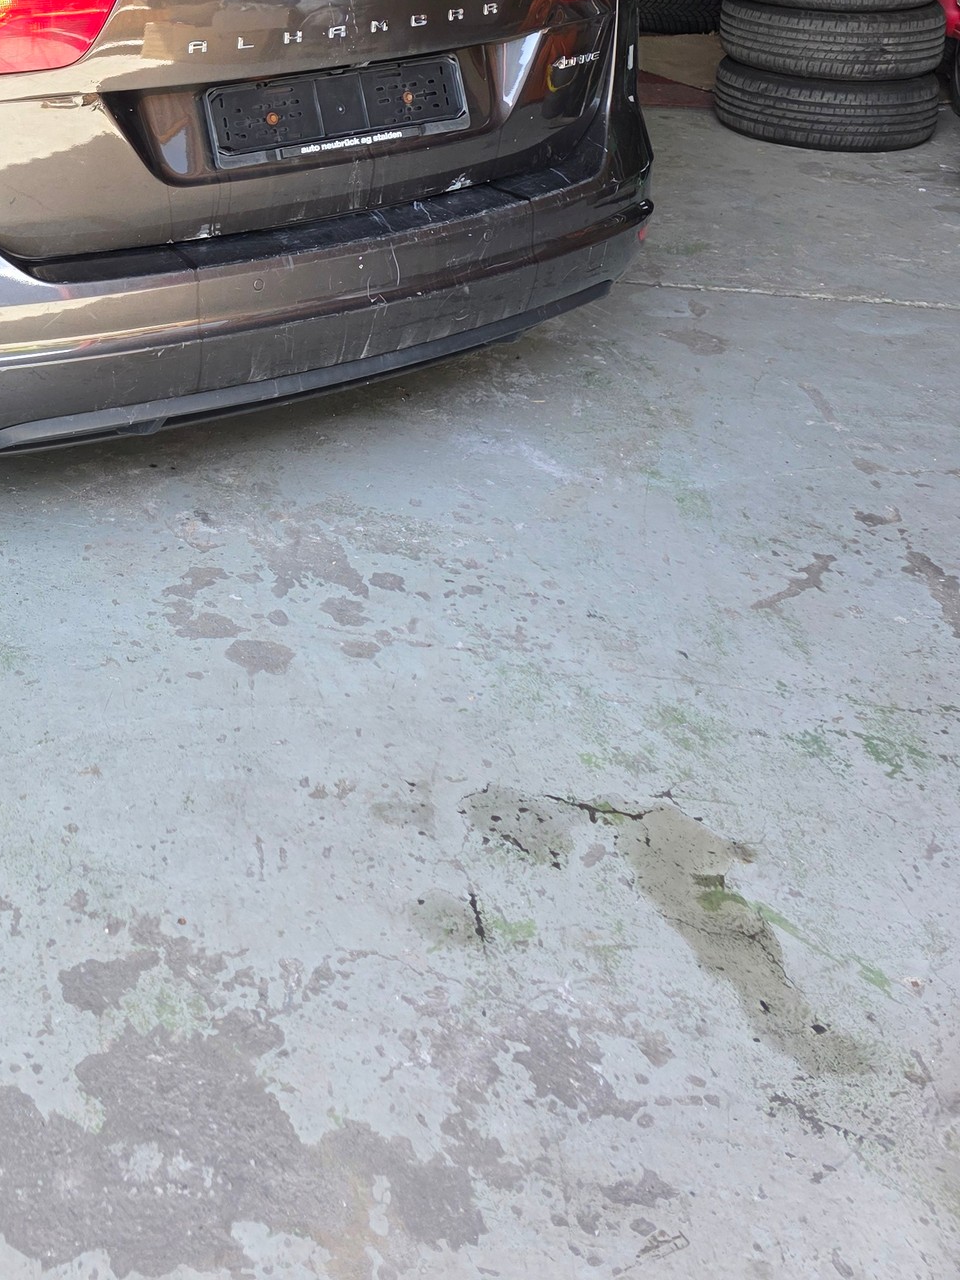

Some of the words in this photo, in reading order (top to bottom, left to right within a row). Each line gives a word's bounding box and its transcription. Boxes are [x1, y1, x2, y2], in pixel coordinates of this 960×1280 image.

[188, 2, 499, 54] ALHAMBRA
[301, 144, 321, 154] auto
[321, 137, 360, 150] neubrück
[373, 131, 402, 142] stalden
